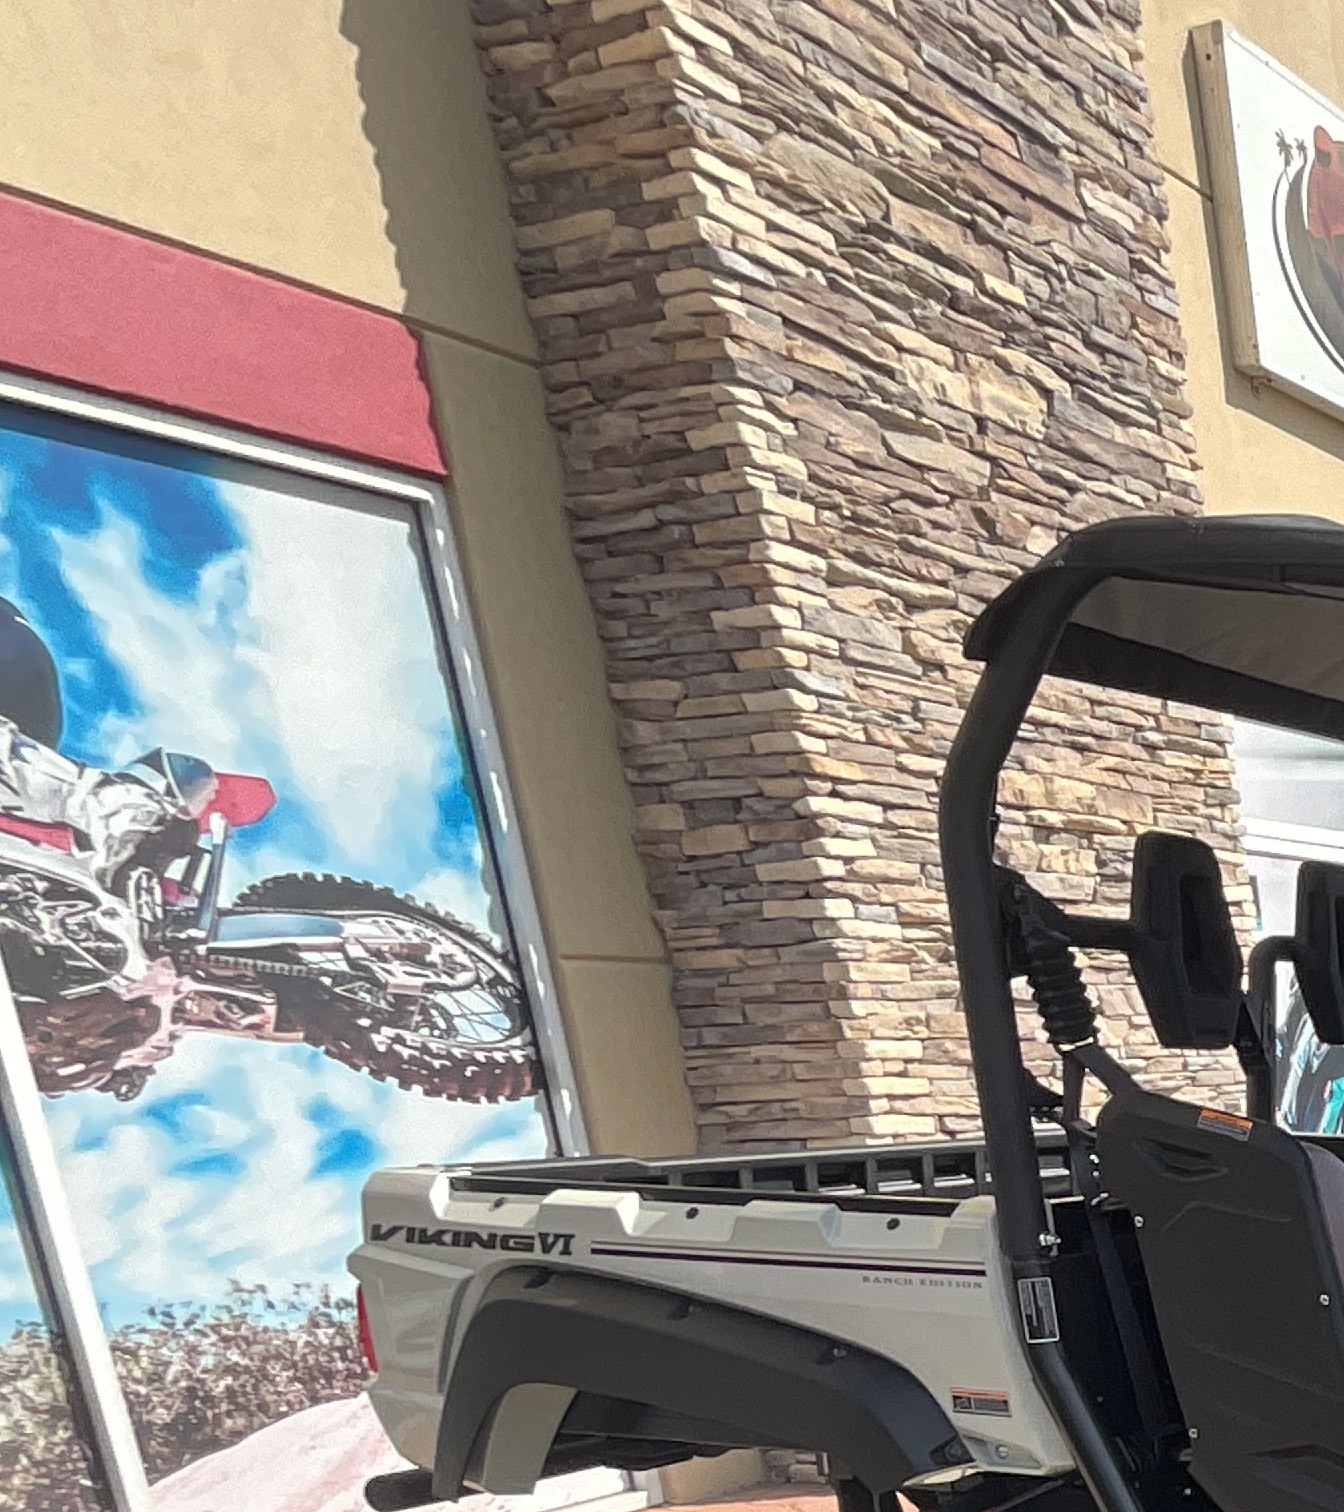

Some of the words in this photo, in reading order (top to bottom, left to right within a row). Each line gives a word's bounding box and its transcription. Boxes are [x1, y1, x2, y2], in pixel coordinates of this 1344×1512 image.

[371, 1224, 535, 1252] VIKING
[861, 1275, 914, 1286] RANCH
[918, 1278, 984, 1290] EDITION
